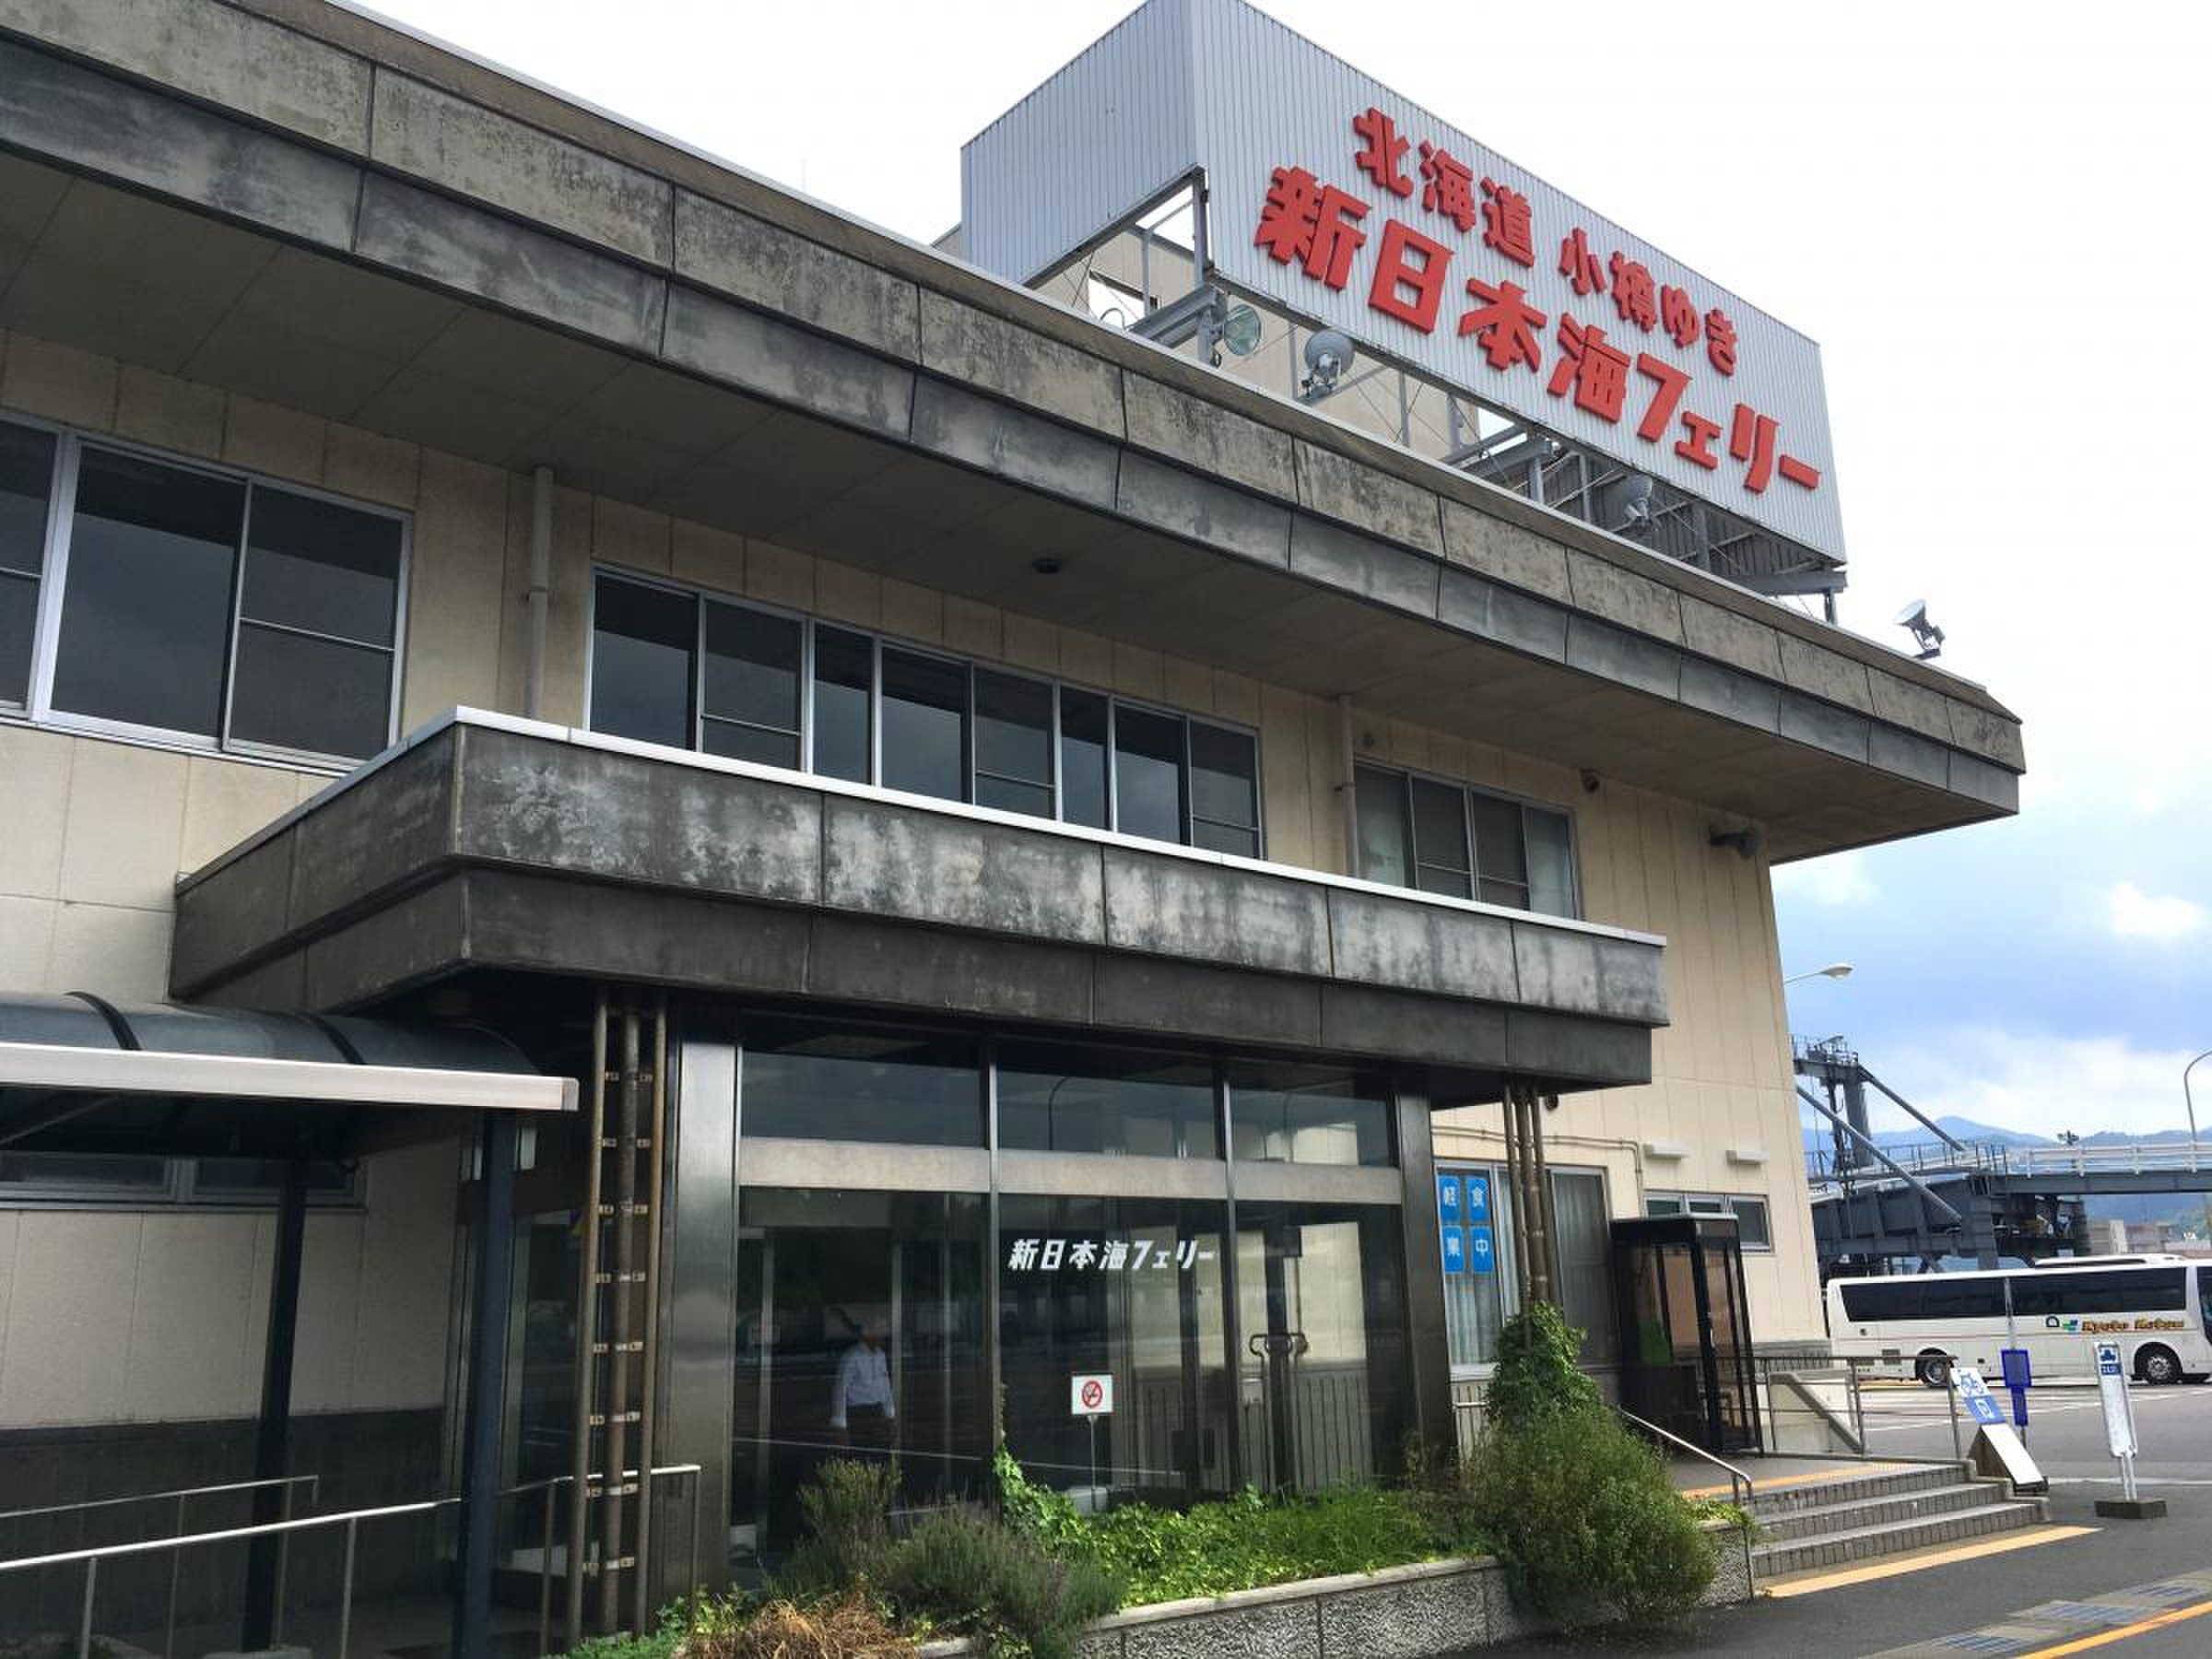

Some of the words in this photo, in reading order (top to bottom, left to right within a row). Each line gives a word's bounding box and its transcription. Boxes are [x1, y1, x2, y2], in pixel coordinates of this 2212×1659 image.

[1254, 165, 1821, 493] 新日本海フェリー
[1353, 107, 1535, 267] 北海道
[1559, 228, 1738, 376] 小樽ゆき
[1007, 1238, 1215, 1271] 新日本海フェリー
